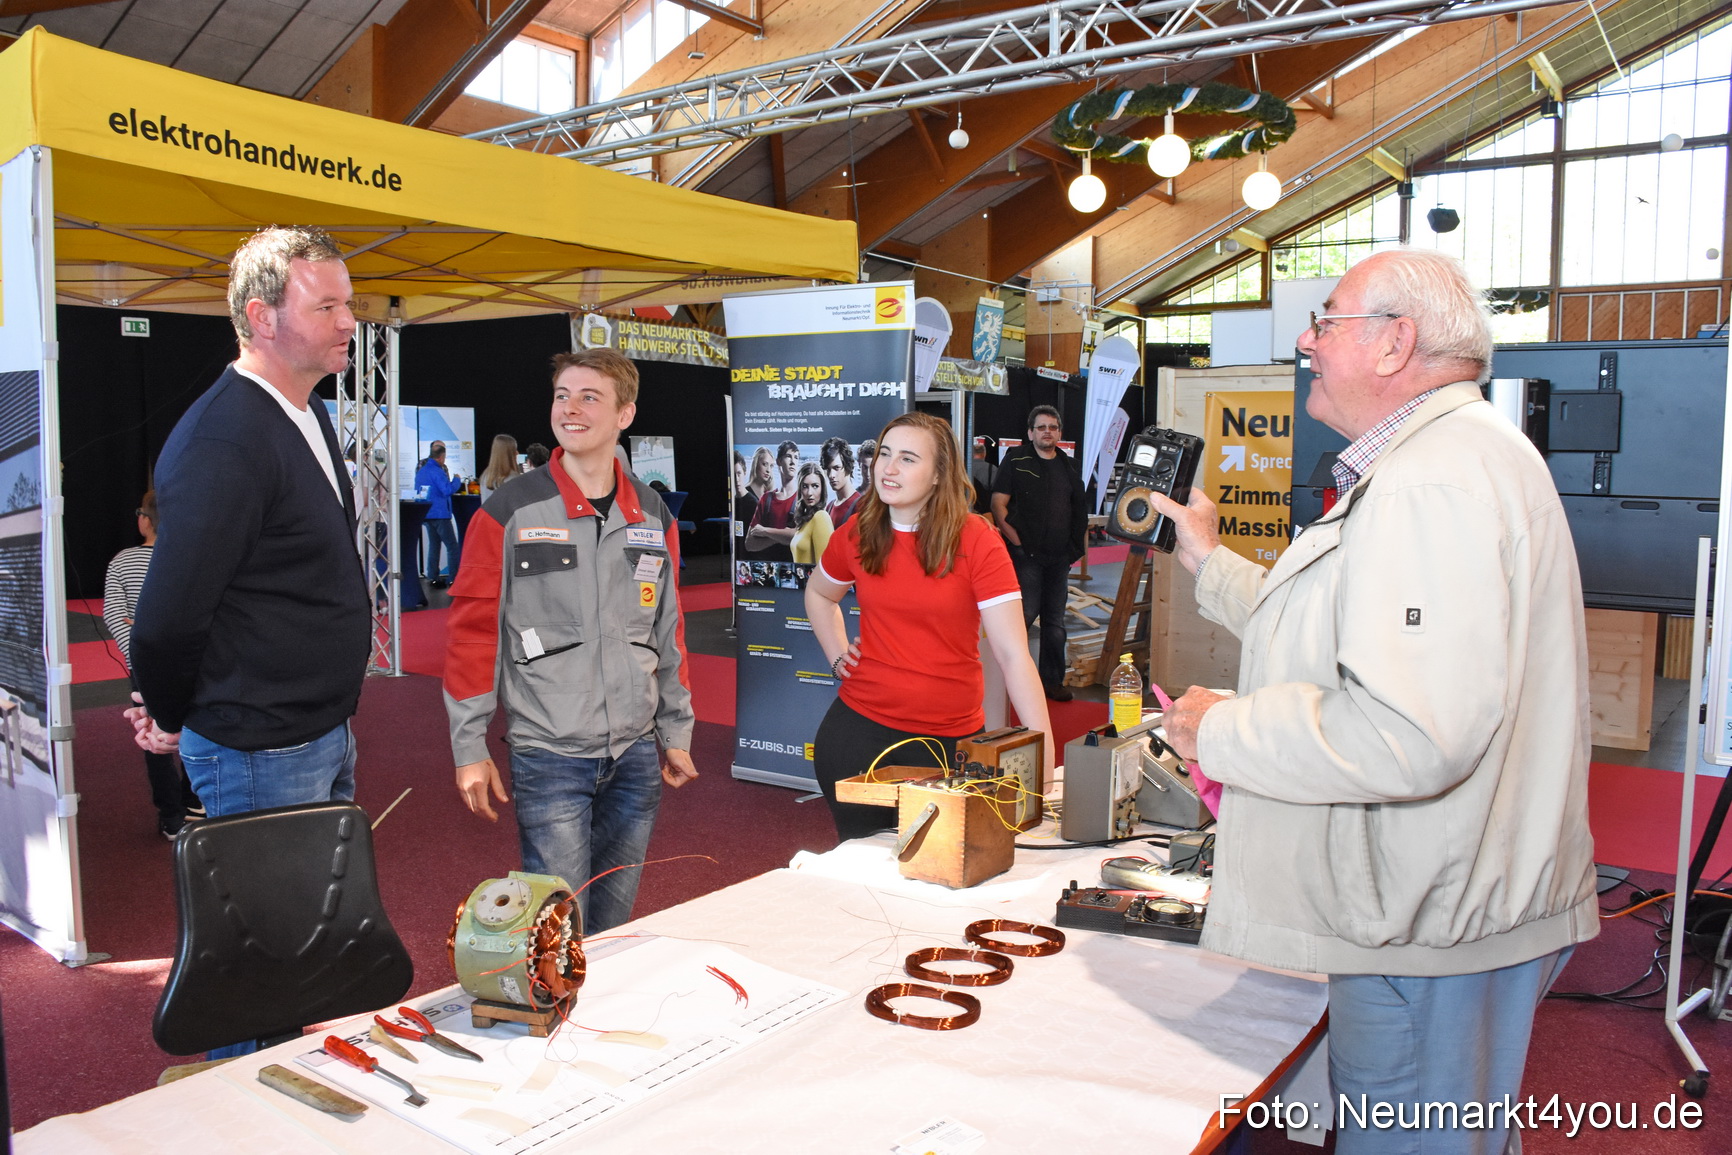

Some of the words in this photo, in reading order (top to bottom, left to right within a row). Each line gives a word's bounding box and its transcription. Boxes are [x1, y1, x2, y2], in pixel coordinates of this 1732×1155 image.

[108, 107, 403, 192] elektrohandwerk.de
[618, 321, 639, 335] DAS
[642, 323, 710, 344] NEUMARKTER
[914, 335, 928, 344] wn
[619, 337, 680, 355] HANDWERK
[680, 343, 714, 359] STELLT
[716, 349, 729, 360] SIC
[731, 364, 781, 383] DEINE
[784, 365, 843, 382] STADT
[936, 372, 957, 383] STELLT
[959, 374, 973, 385] SICH
[1098, 365, 1117, 375] swn
[767, 382, 856, 401] BRAUCHT
[859, 382, 907, 400] DICH
[1222, 407, 1290, 438] Neu
[1250, 453, 1292, 473] Sprec
[1219, 485, 1292, 507] Zimme
[535, 531, 561, 539] Hofmann
[633, 531, 654, 539] NIBLER
[739, 737, 803, 756] E-ZUBIS.DE
